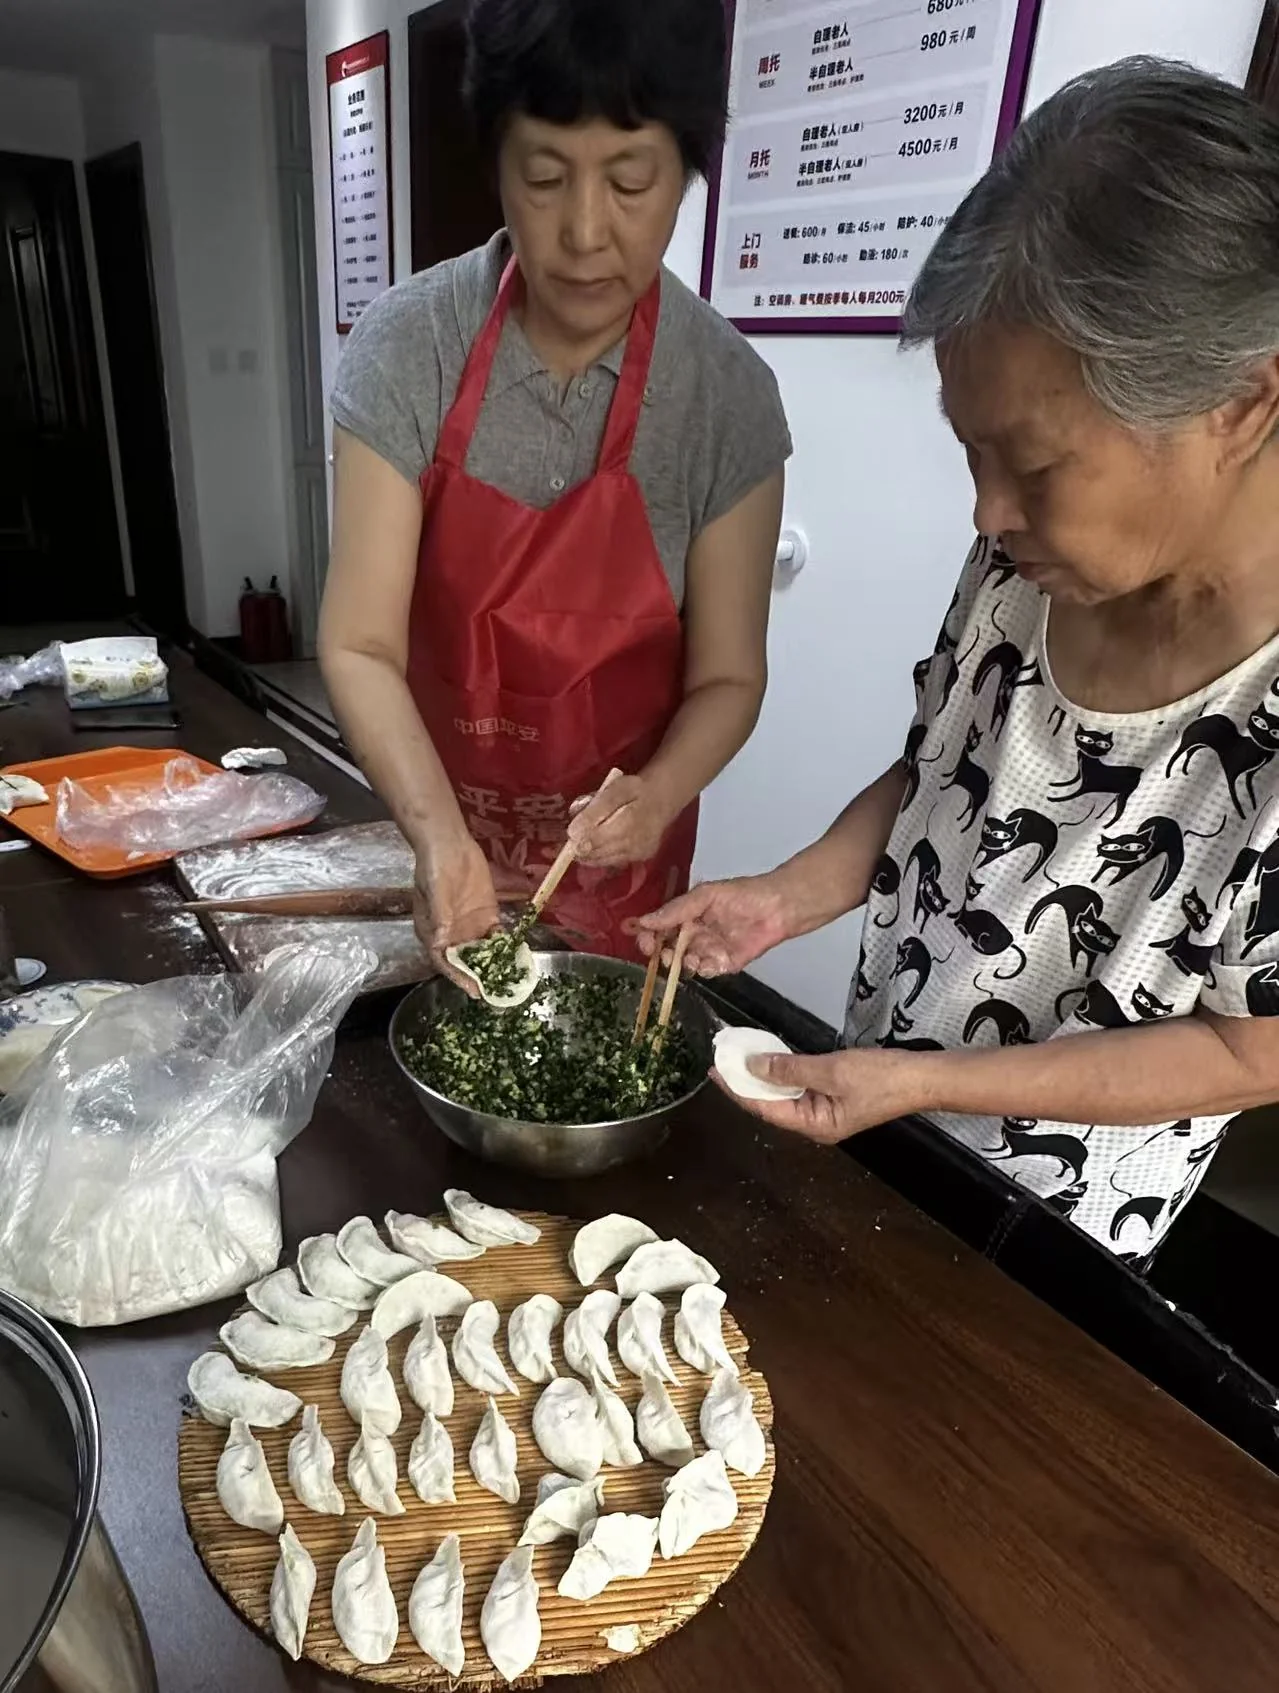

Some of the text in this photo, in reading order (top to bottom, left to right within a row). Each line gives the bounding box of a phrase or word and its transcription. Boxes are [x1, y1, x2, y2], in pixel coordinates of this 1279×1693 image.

[757, 53, 781, 76] 周托
[903, 101, 964, 124] 3200元/月
[898, 137, 958, 158] 4500元/月
[749, 149, 771, 169] 月托
[741, 232, 761, 249] 上门
[739, 252, 759, 270] 服务
[453, 717, 540, 742] 中国平安
